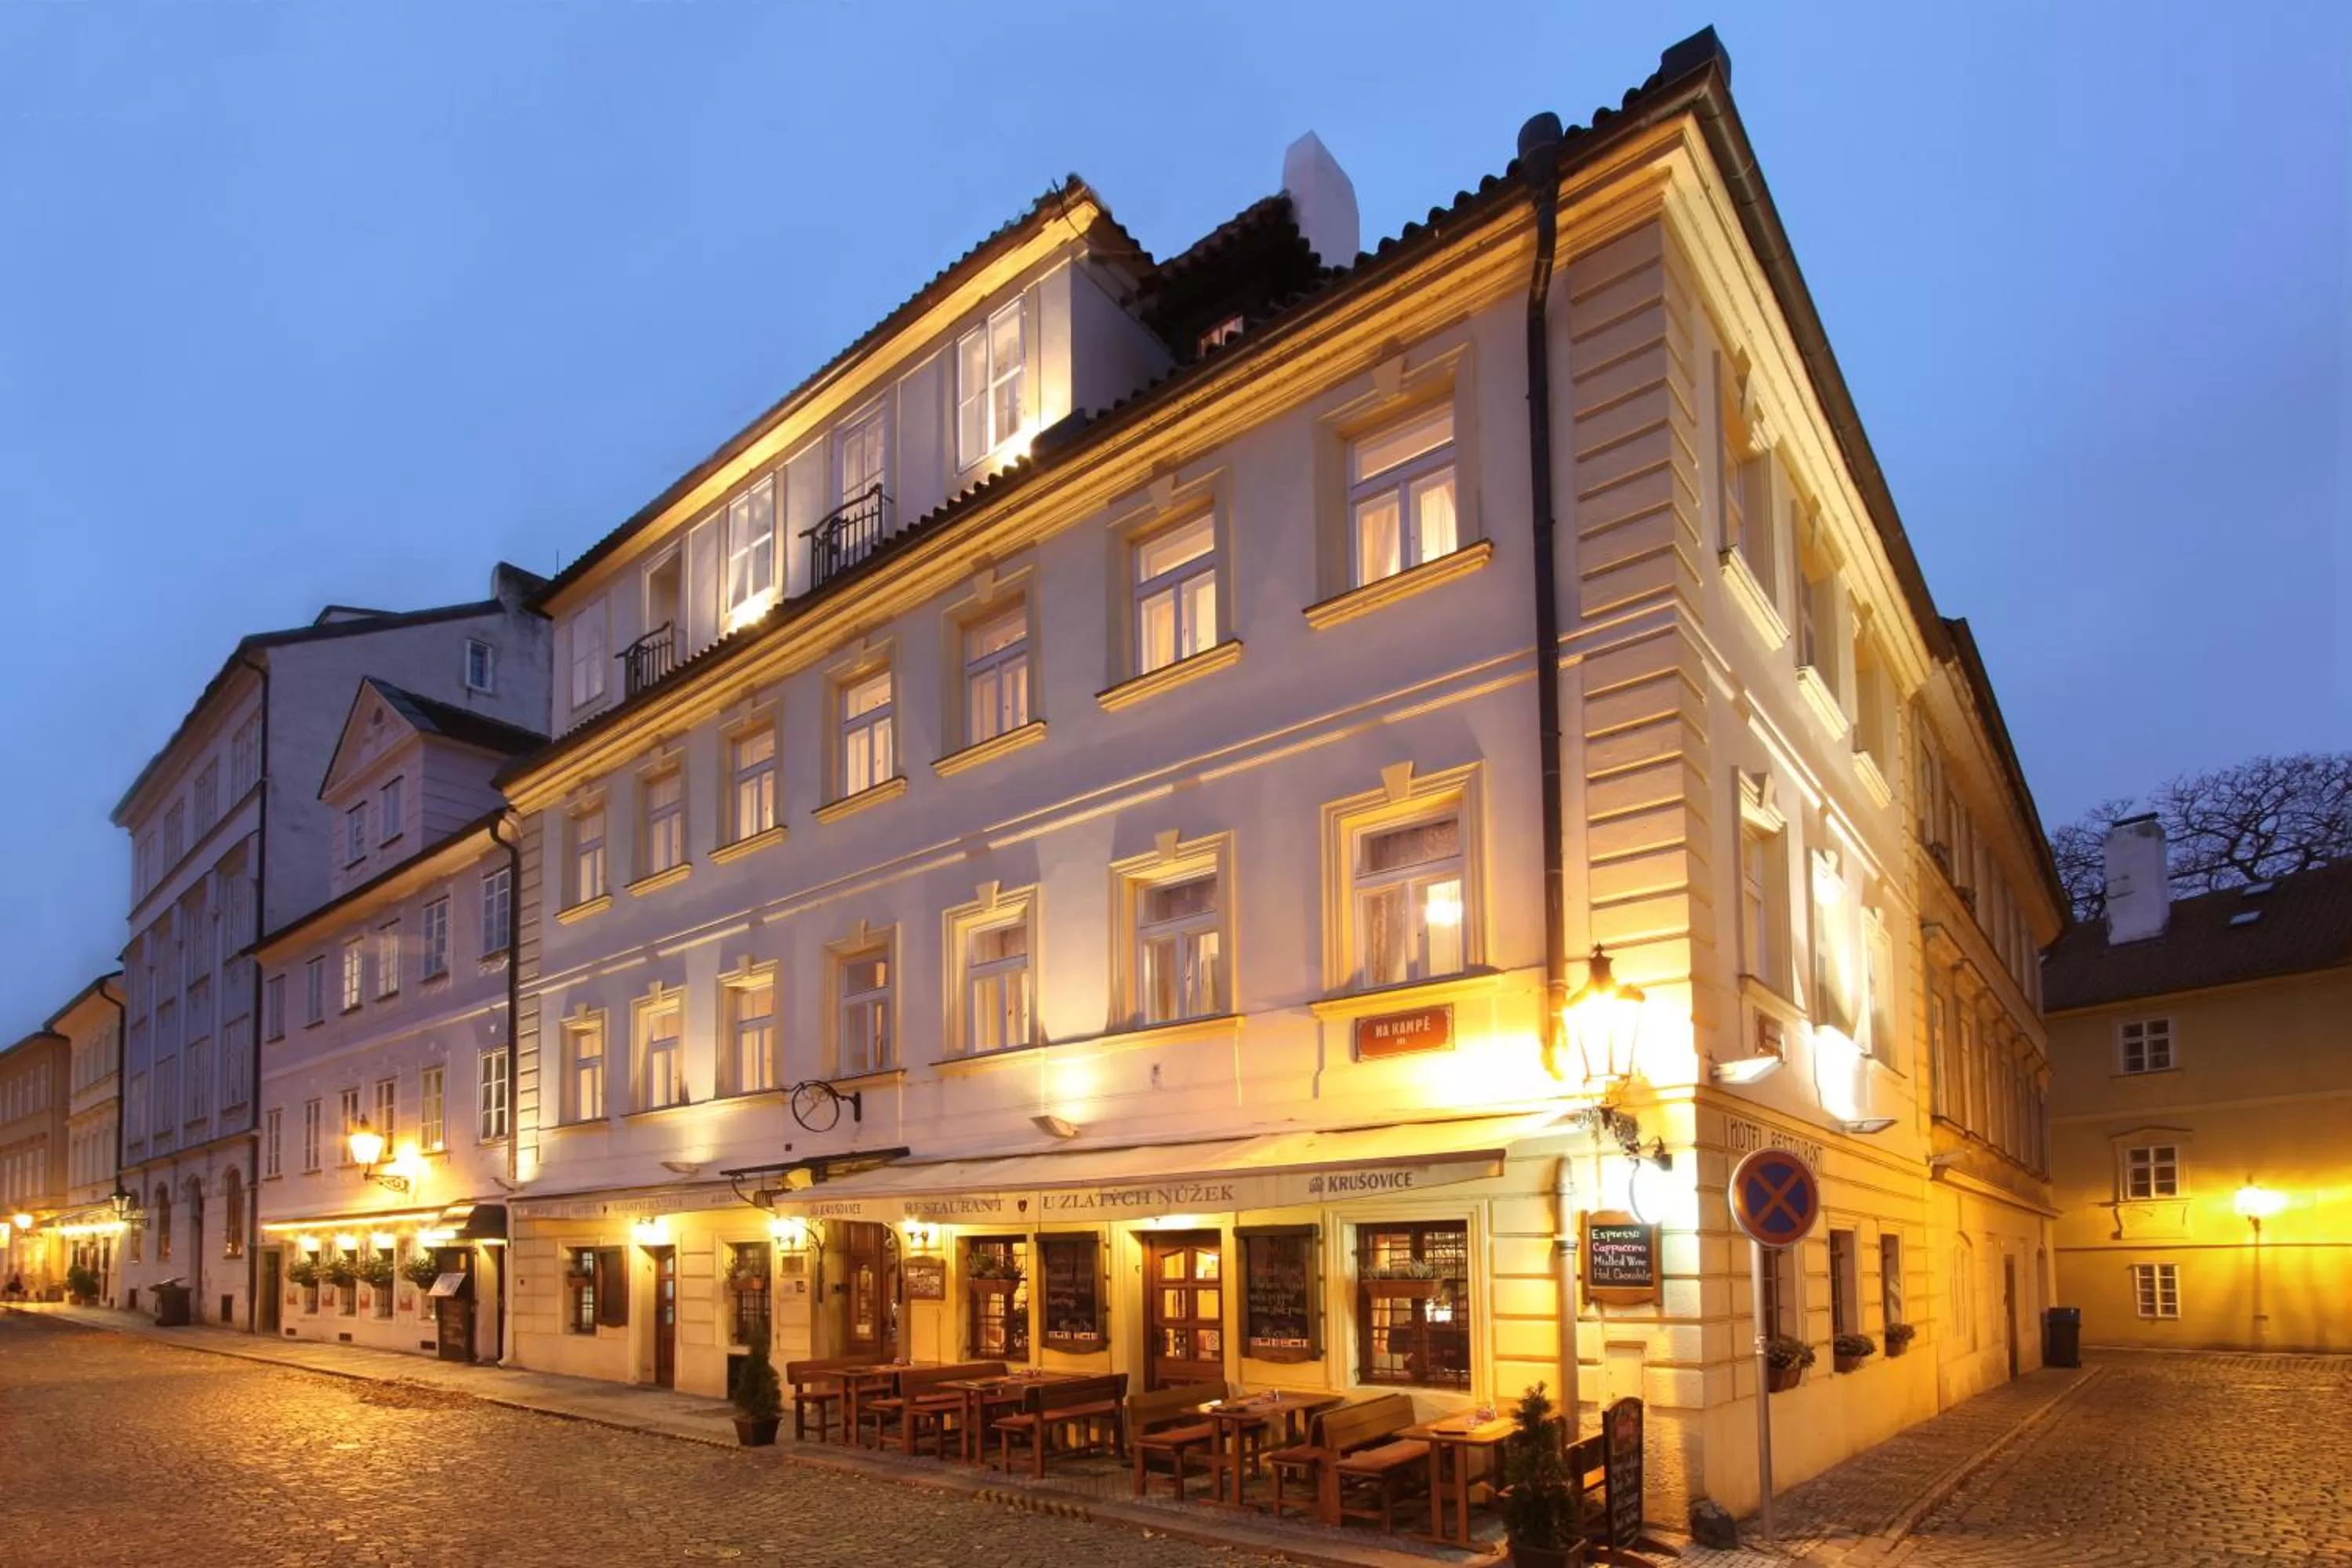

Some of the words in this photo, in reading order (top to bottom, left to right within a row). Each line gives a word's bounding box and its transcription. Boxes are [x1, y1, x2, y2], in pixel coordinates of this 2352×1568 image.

[1375, 1022, 1389, 1039] NA
[1328, 1171, 1414, 1192] KRUŠOVICE
[903, 1198, 1004, 1215] RESTAURANT
[1043, 1196, 1055, 1209] U
